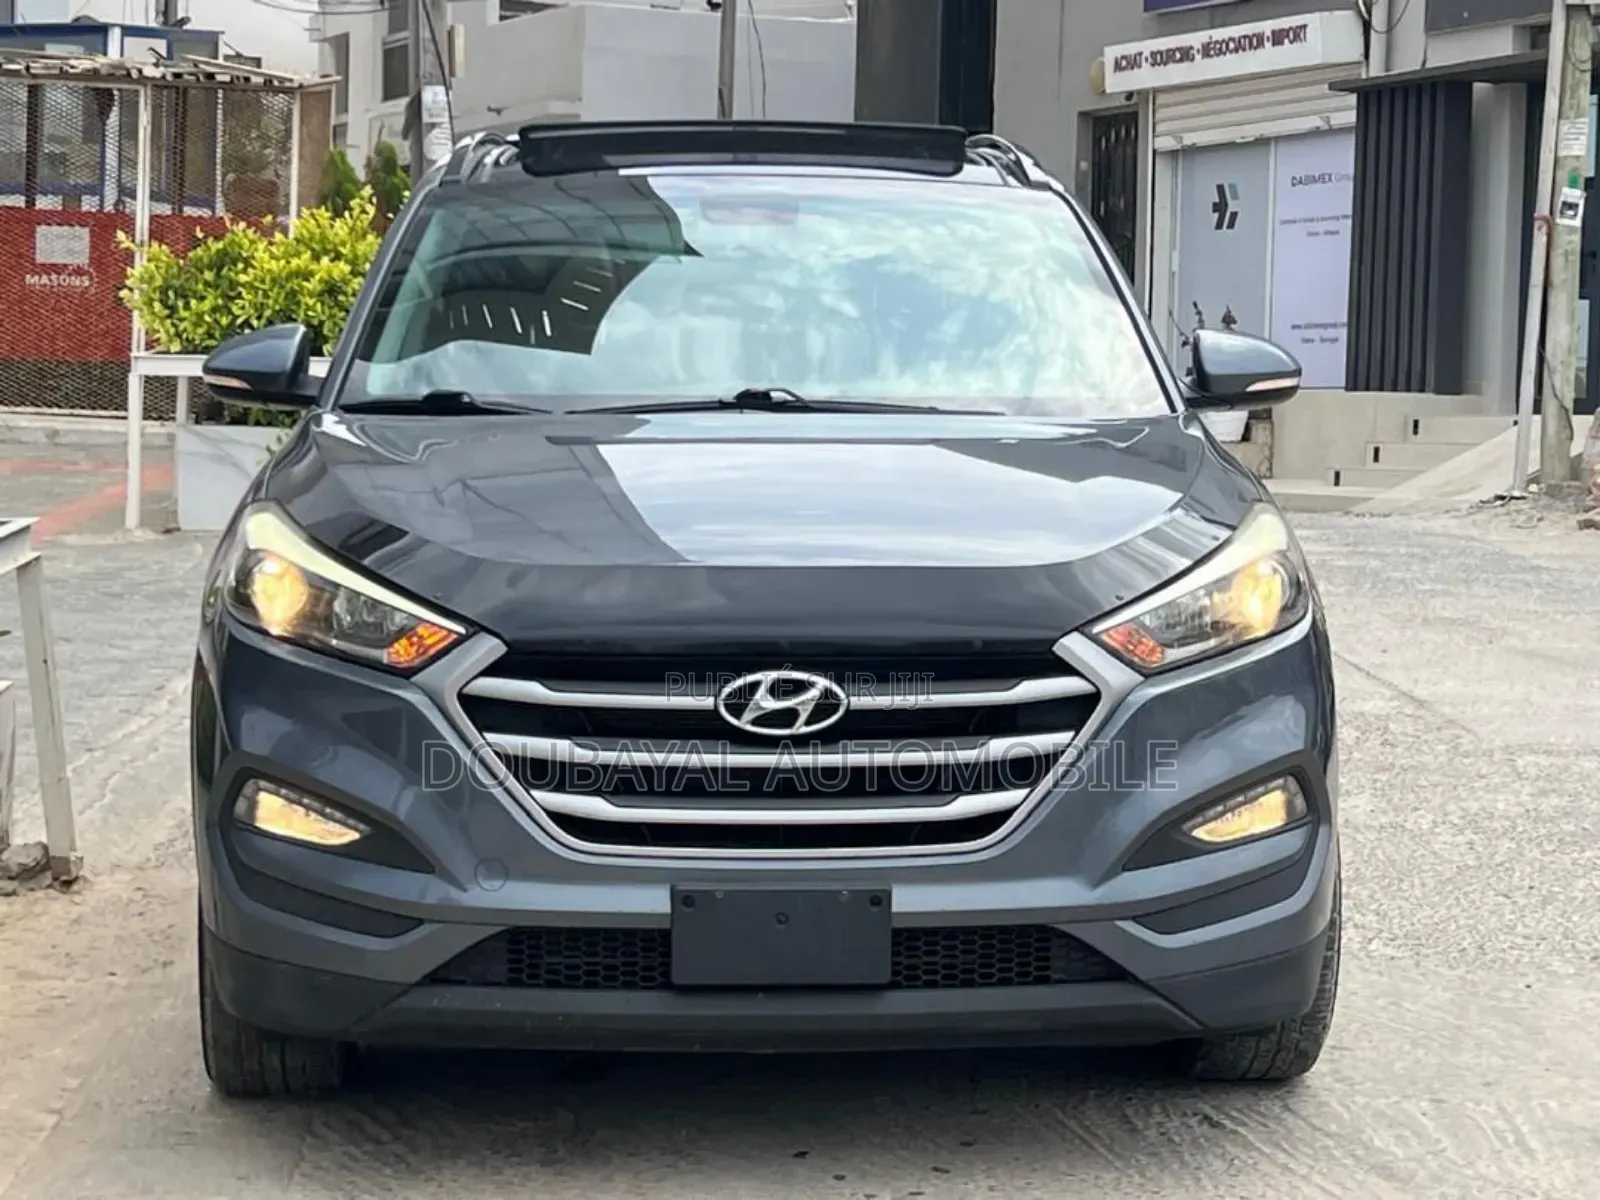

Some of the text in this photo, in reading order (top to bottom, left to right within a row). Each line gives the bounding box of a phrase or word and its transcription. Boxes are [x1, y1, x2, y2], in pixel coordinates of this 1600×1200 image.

[1113, 24, 1309, 73] ACHAT SOURCING NÉGOCIATION IMPORT
[1291, 172, 1333, 187] DABIMEX
